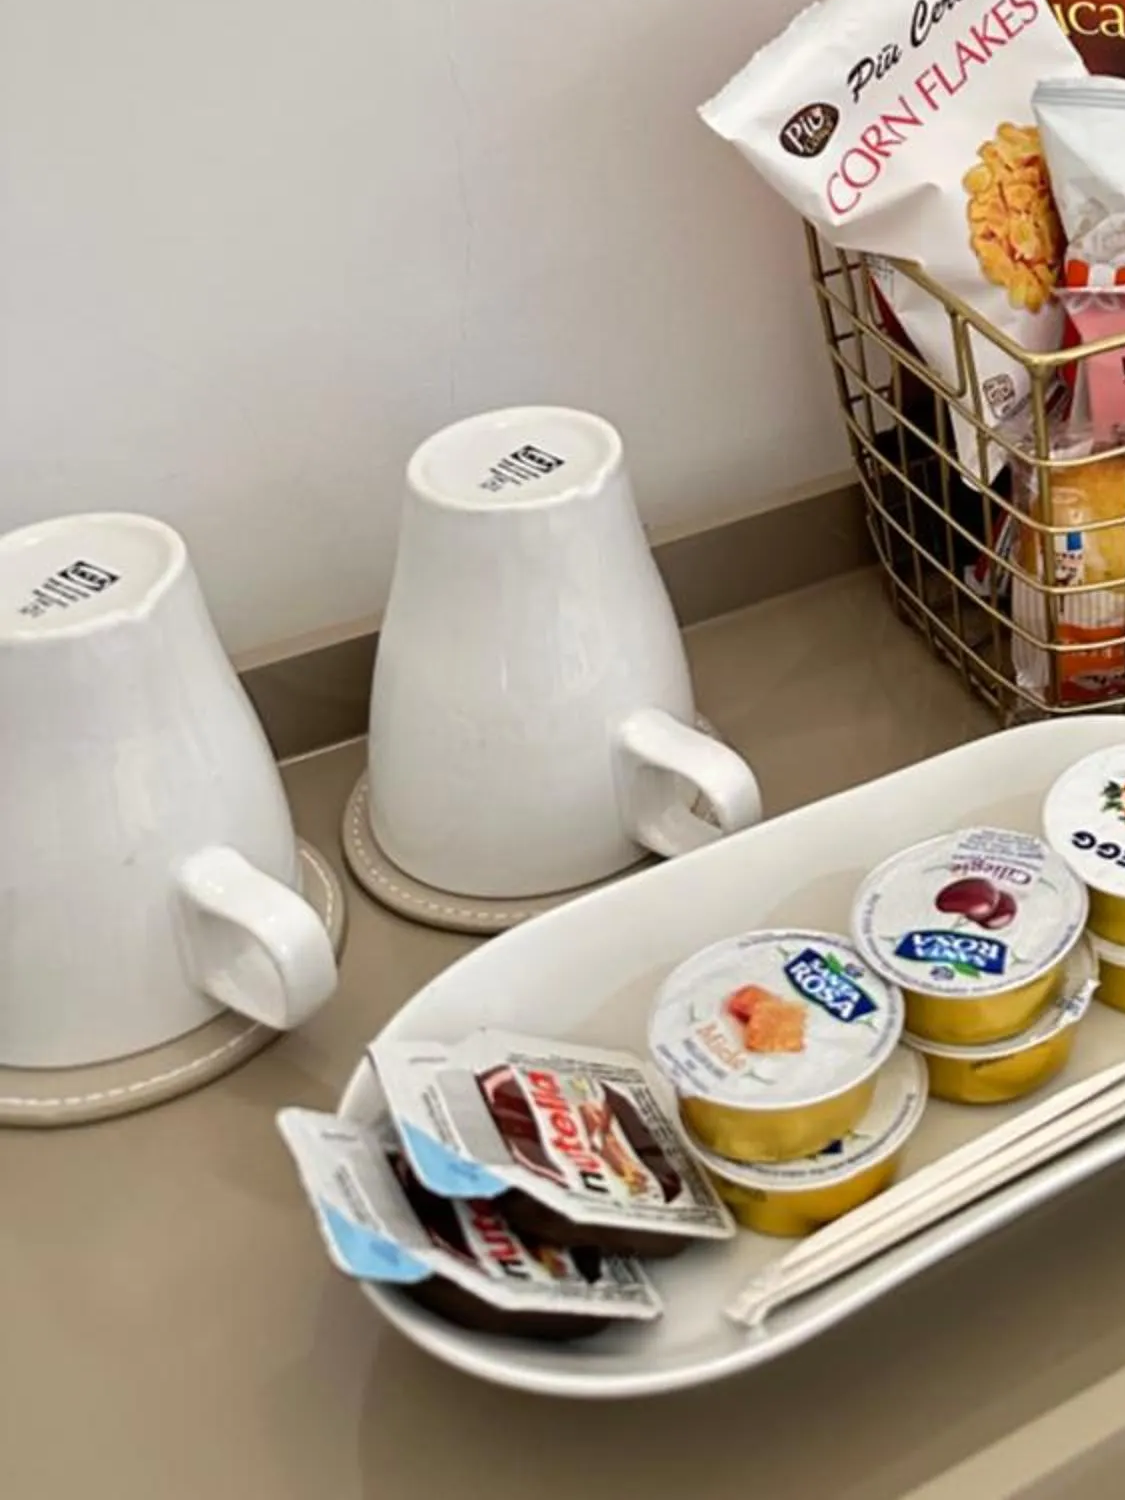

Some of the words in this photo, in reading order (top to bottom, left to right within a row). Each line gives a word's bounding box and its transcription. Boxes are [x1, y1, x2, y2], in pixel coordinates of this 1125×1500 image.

[827, 95, 924, 214] CORN
[951, 857, 1031, 885] Ciliegie
[911, 933, 1000, 959] ROSA
[914, 946, 987, 967] SANTA
[790, 962, 857, 1018] ROSA
[527, 1070, 608, 1193] nutella
